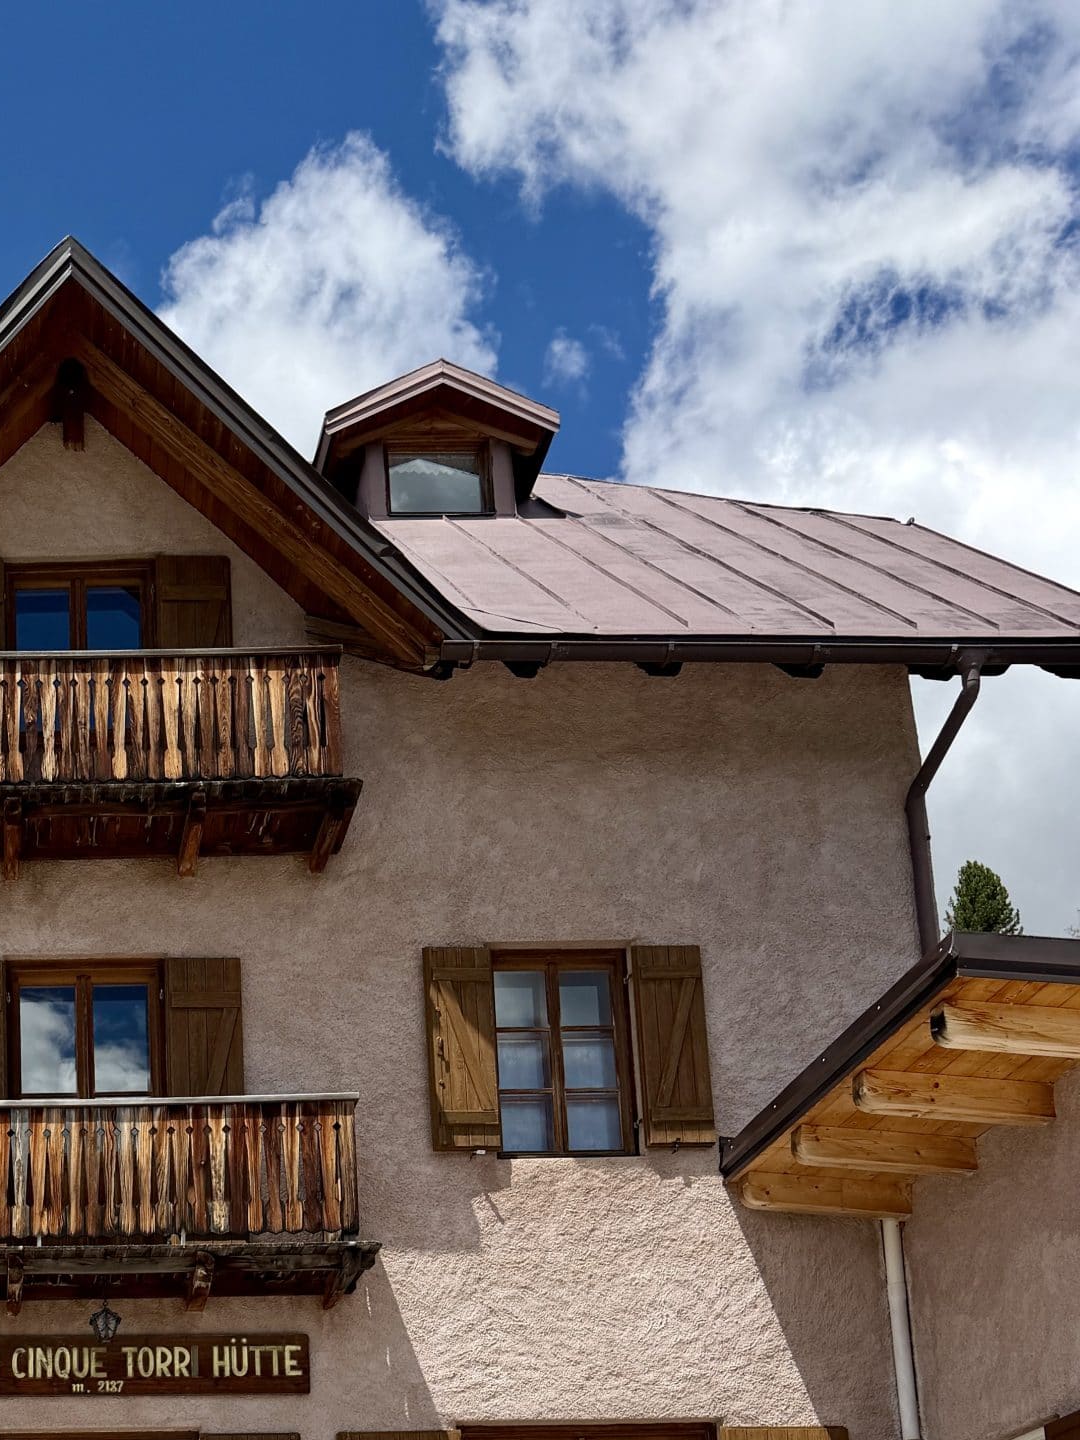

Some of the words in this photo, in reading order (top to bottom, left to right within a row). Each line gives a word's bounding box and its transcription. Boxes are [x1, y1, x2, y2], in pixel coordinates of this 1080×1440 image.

[12, 1347, 108, 1380] CINQUE
[122, 1345, 199, 1378] TORRI
[213, 1337, 303, 1377] HÜTTE
[97, 1380, 124, 1393] 2137
